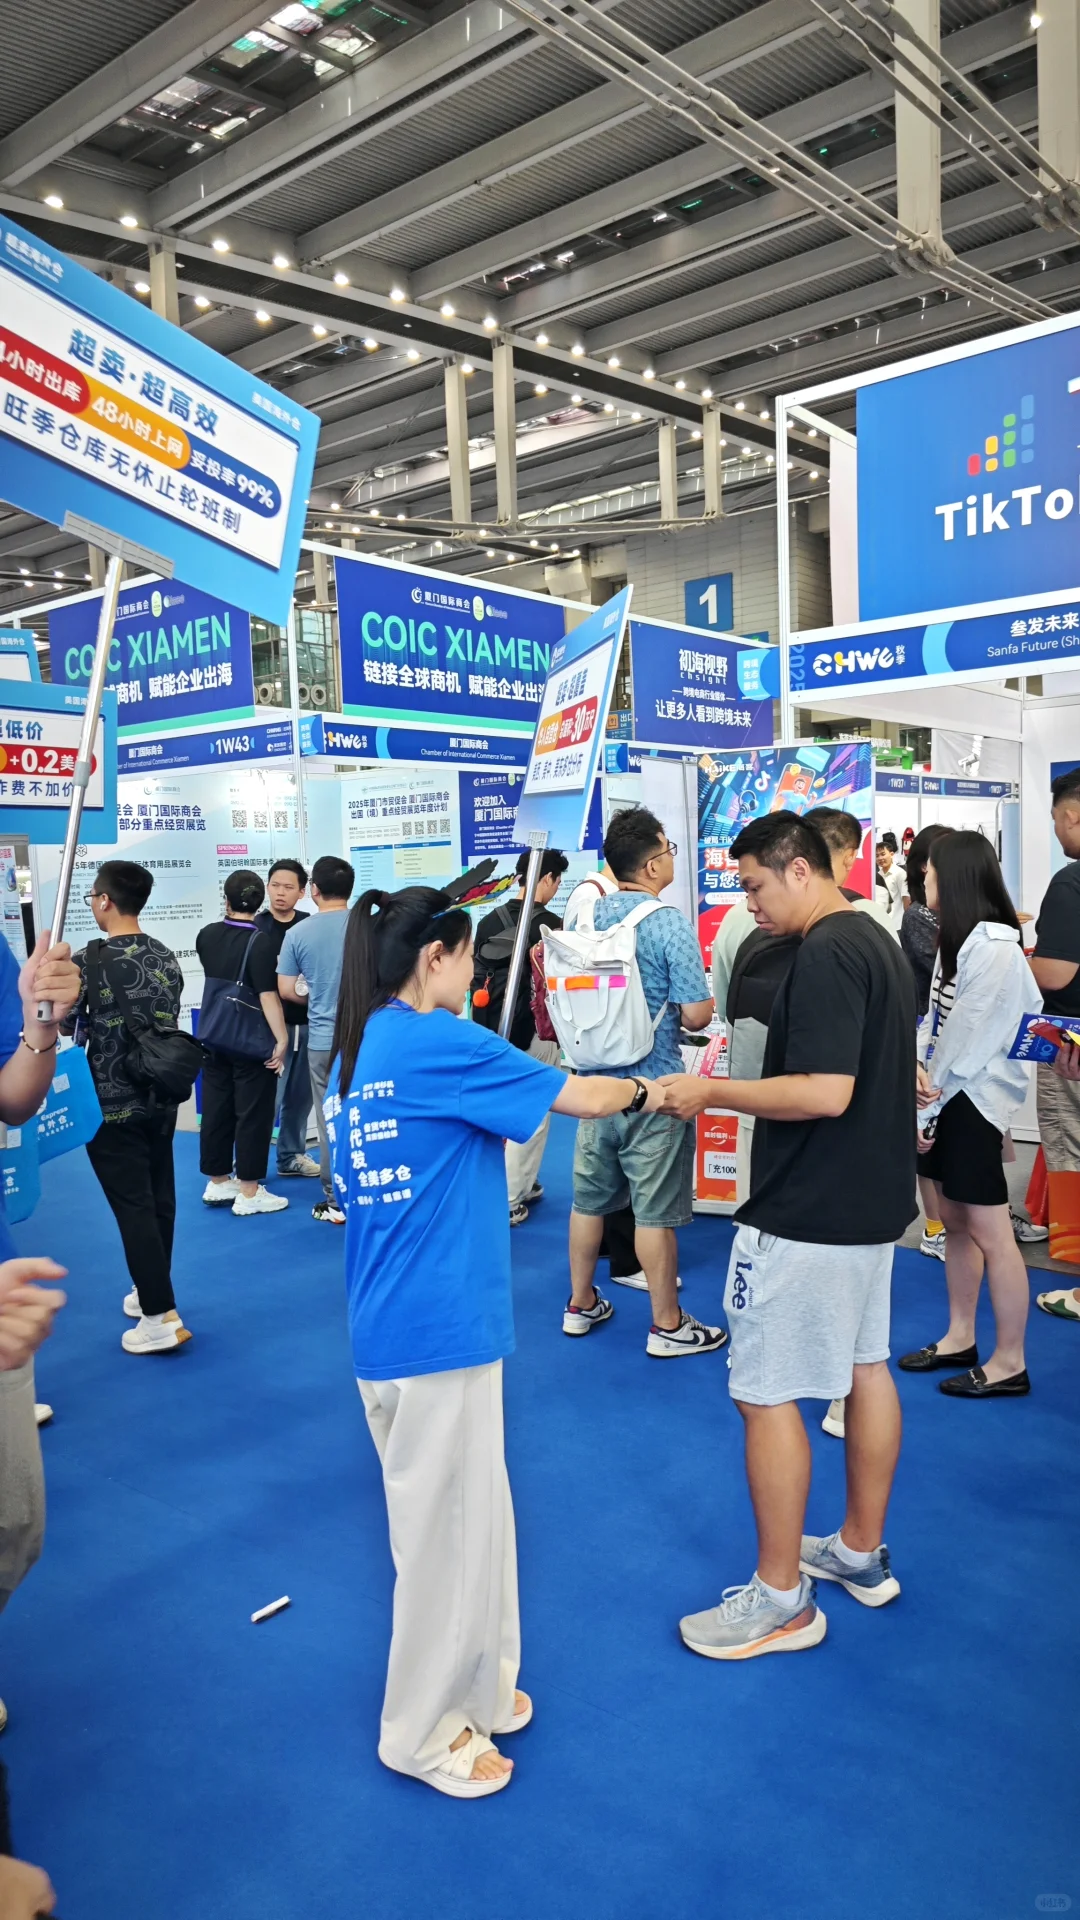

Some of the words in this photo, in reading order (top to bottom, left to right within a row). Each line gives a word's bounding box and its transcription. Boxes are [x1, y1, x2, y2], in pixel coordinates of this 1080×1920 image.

[67, 328, 219, 437] 超卖·超高效
[92, 396, 184, 459] 48小时上网
[190, 447, 274, 509] 妥投率99%
[3, 392, 242, 535] 旺季仓库无休止轮班制
[935, 477, 1080, 541] TikTo
[116, 600, 149, 617] 门国际商会
[424, 591, 471, 610] 厦门国际商会
[698, 584, 719, 625] 1
[0, 637, 26, 646] 国海外仓
[65, 638, 122, 680] COC
[127, 612, 231, 668] XIAMEN
[361, 611, 438, 656] COIC
[446, 625, 549, 672] XIAMEN
[987, 644, 1019, 657] Sanfa
[1021, 640, 1059, 653] Future
[103, 680, 142, 705] 商机
[149, 662, 233, 699] 赋能企业出海
[363, 659, 461, 694] 链接全球商机
[655, 699, 753, 728] 让更多人看到跨境未来
[0, 719, 44, 741] 低价
[215, 735, 250, 755] 1W43
[324, 731, 362, 750] HWE
[449, 737, 489, 750] 厦门国际商会
[9, 748, 79, 774] +0.2美
[128, 744, 163, 759] 厦门国际商会
[420, 748, 442, 756] Chamber
[442, 749, 448, 757] of
[448, 750, 477, 758] International
[477, 752, 499, 760] Commerce
[499, 753, 516, 761] Xiamen
[629, 754, 641, 766] WE
[348, 795, 407, 809] 2025年厦门市贸促会
[408, 791, 450, 804] 厦门国际商会
[473, 795, 507, 808] 欢迎加入
[137, 804, 202, 817] 厦门国际商会
[118, 818, 207, 831] 部分重点经贸展览
[40, 1106, 69, 1121] Express
[358, 1164, 412, 1187] 全美多仓
[732, 1260, 753, 1310] Lee
